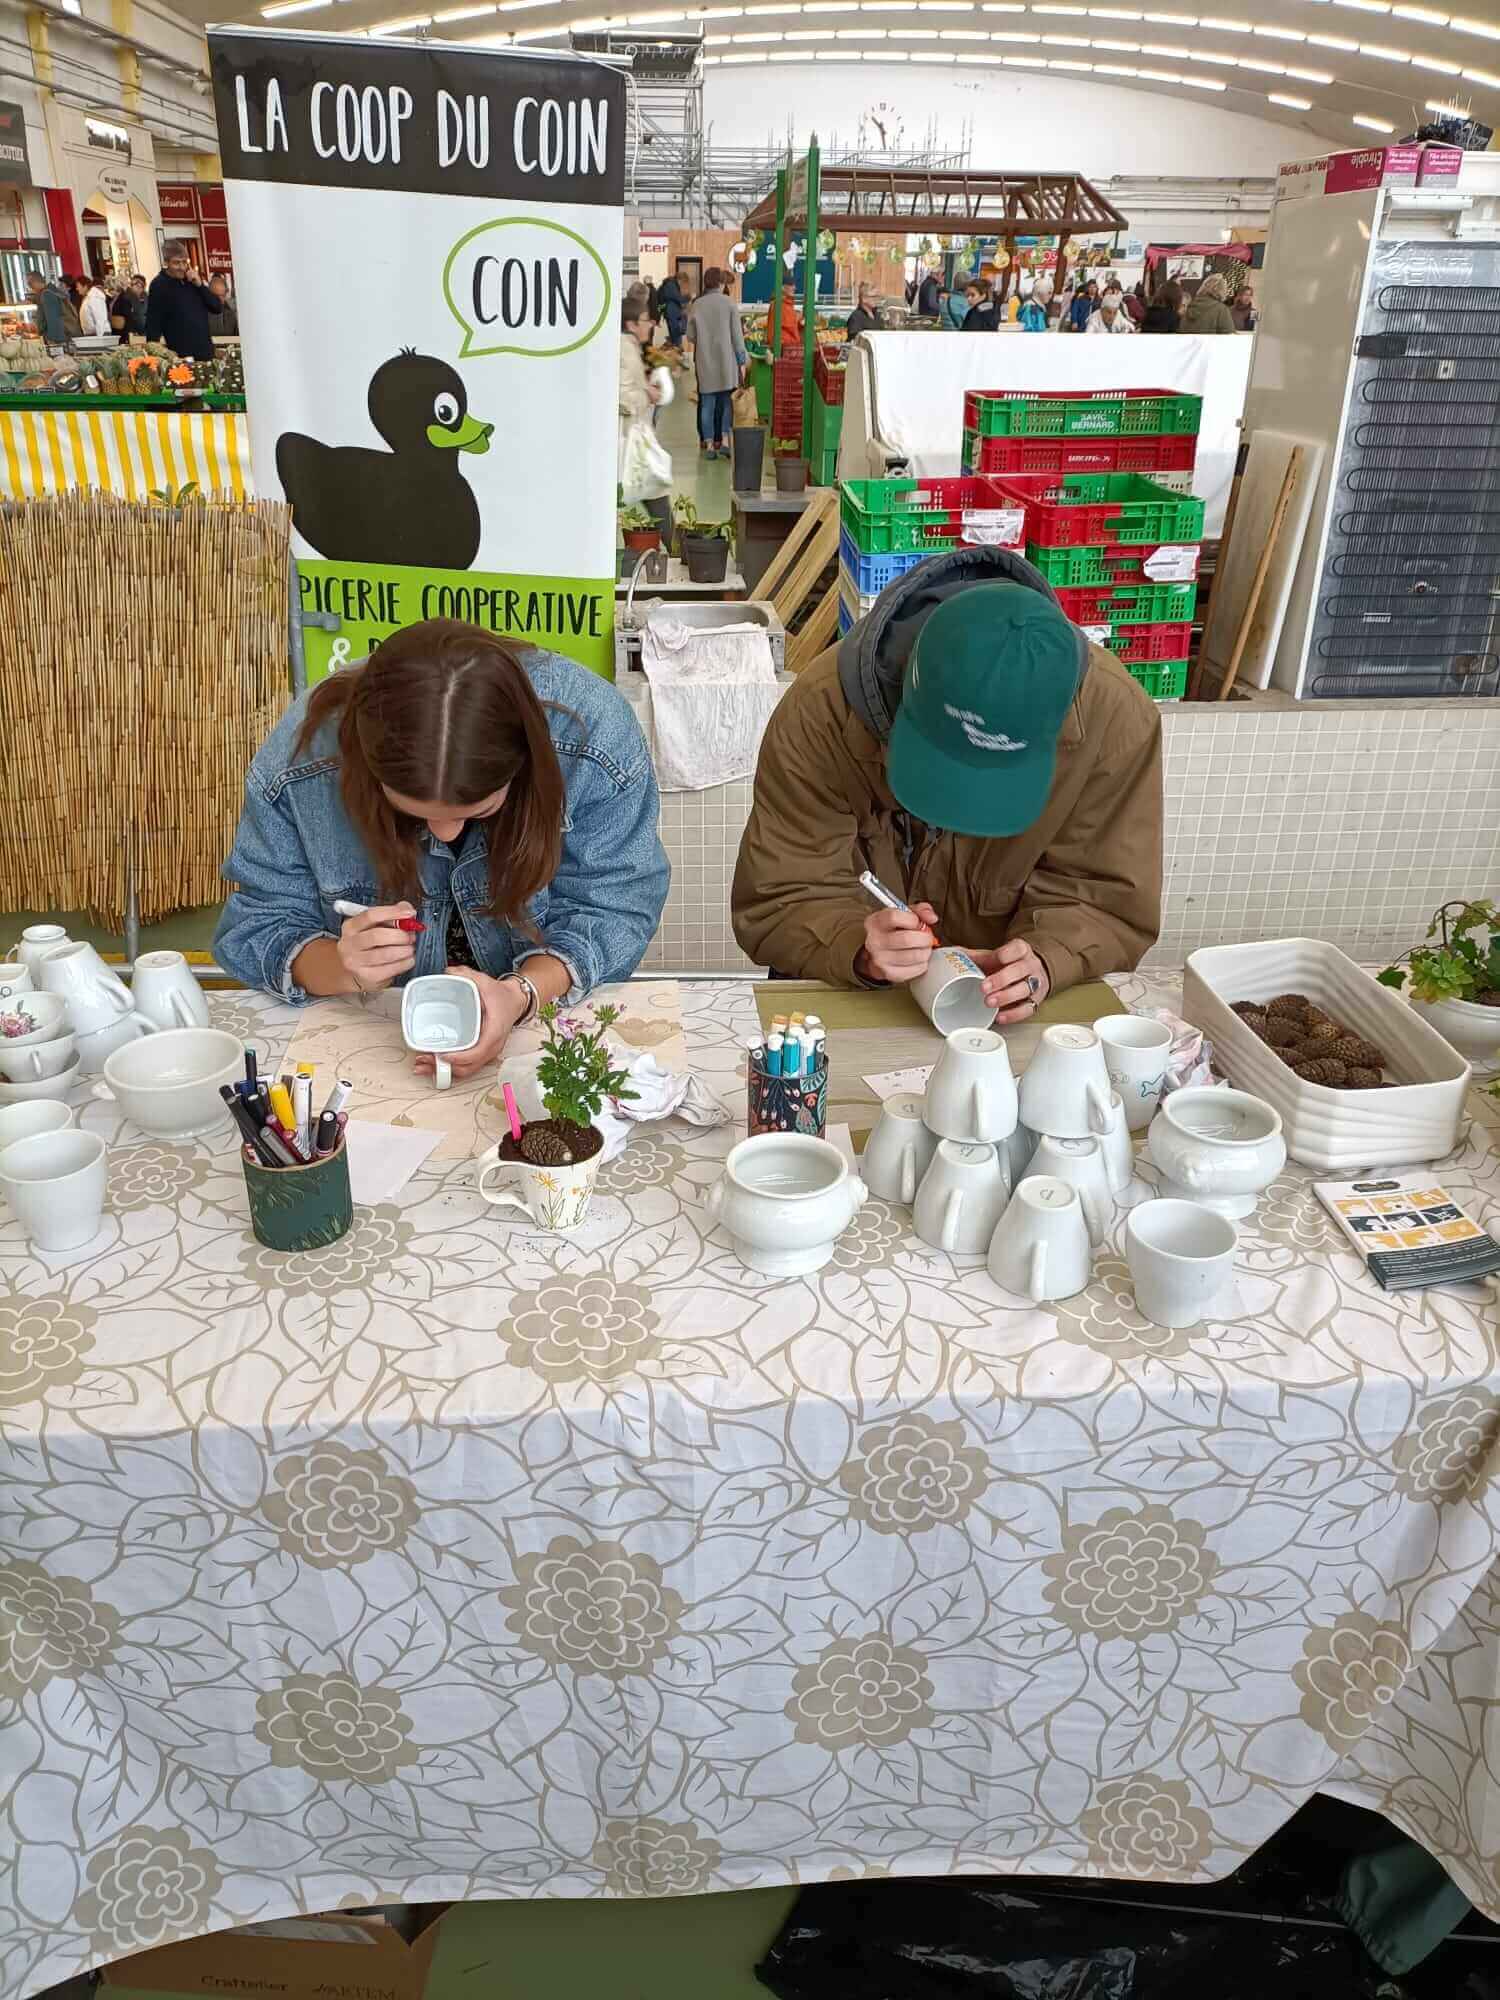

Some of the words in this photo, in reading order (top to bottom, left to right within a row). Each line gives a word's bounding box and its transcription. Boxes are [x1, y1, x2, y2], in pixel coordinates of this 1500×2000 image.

[234, 75, 289, 155] LA
[310, 81, 413, 165] COOP
[436, 93, 489, 169] DU
[513, 97, 609, 176] COIN
[471, 255, 579, 329] COIN
